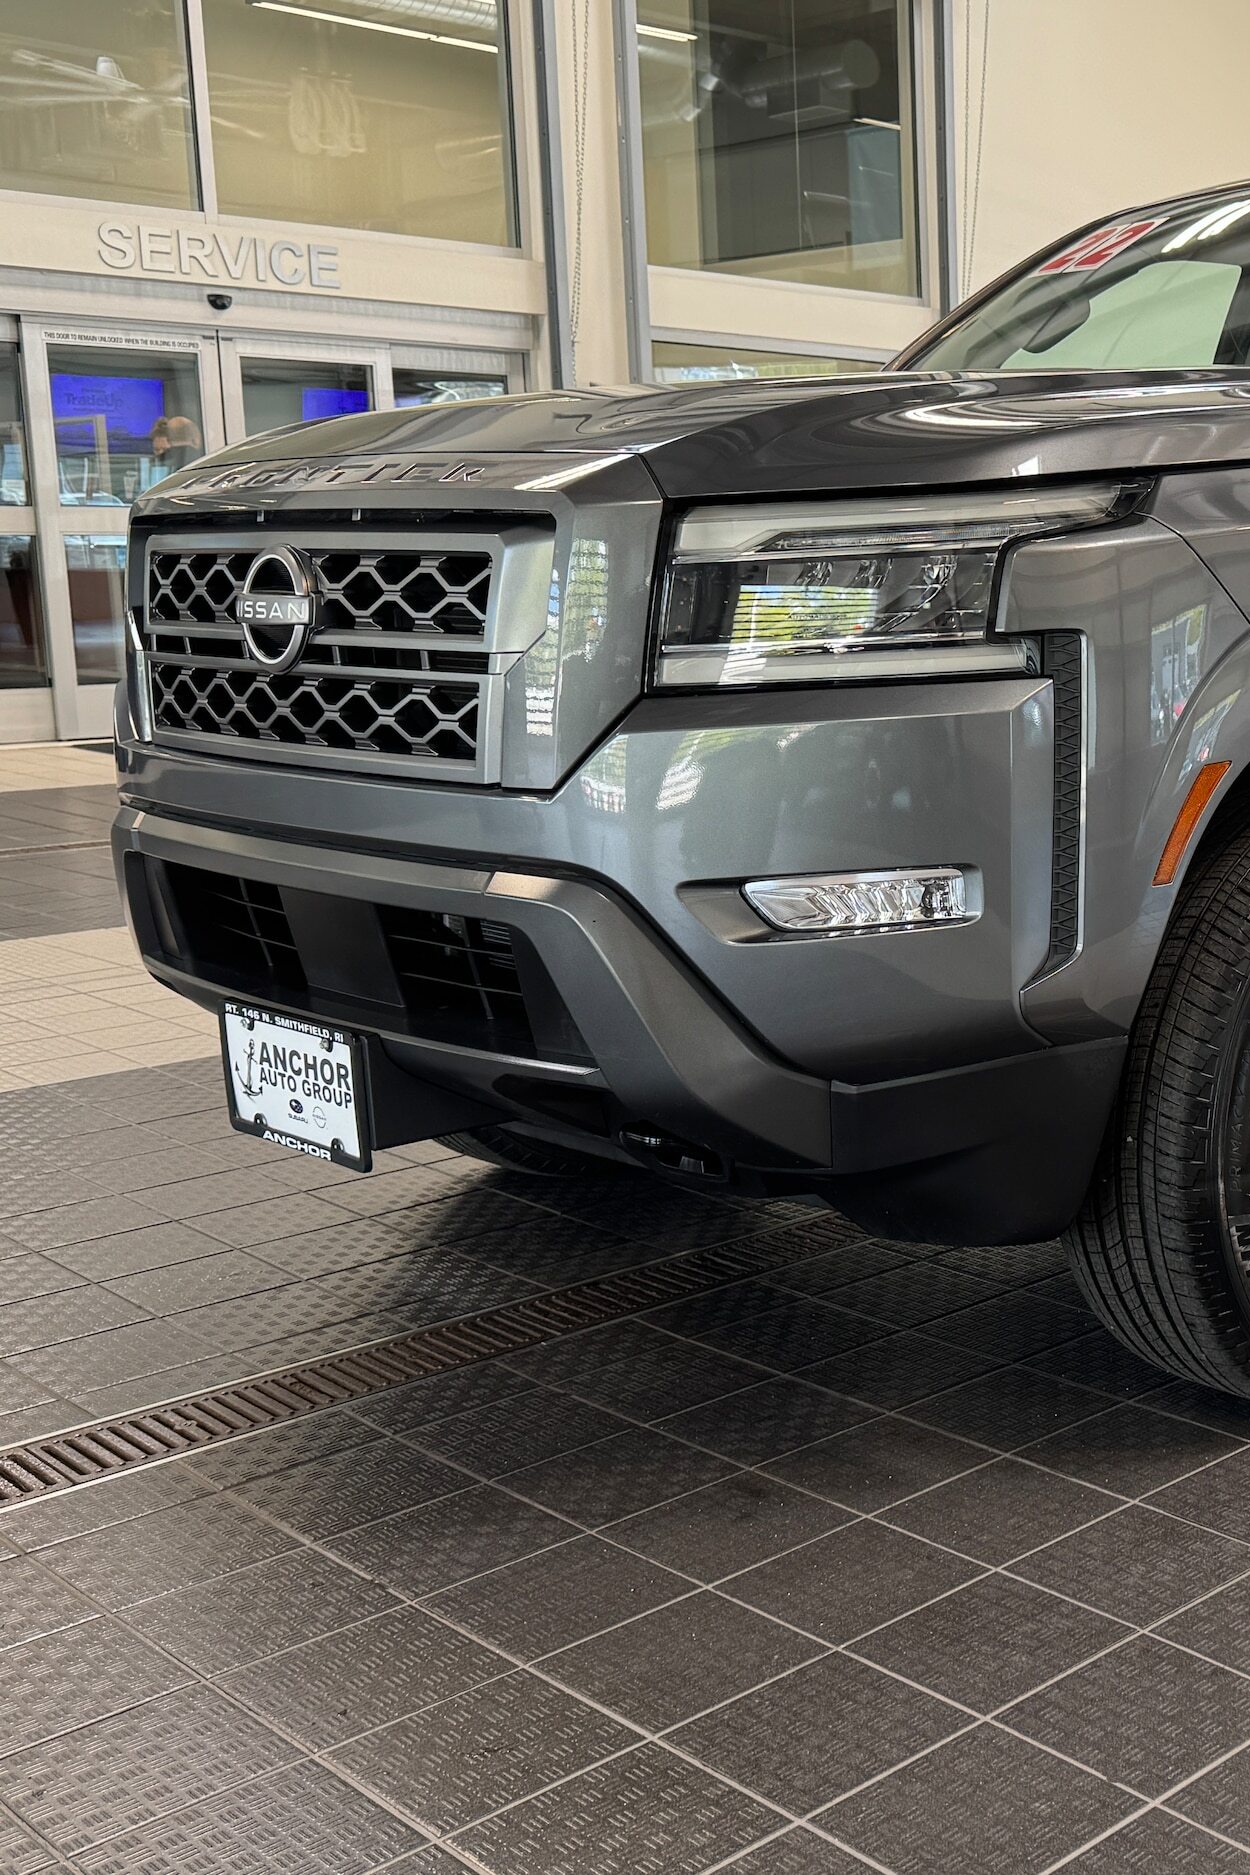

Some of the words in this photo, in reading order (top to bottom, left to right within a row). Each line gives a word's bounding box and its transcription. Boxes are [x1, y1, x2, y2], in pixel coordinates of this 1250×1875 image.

[98, 221, 341, 289] SERVICE
[1038, 221, 1155, 272] 22
[56, 332, 70, 340] DOOR
[78, 334, 97, 342] REMAIN
[98, 335, 123, 344] UNLOCKED
[124, 337, 140, 345] WHEN
[150, 338, 171, 347] BUILDING
[172, 340, 176, 348] IS
[176, 340, 200, 349] OCCUPIED
[224, 1002, 239, 1014] RT.
[242, 1008, 260, 1020] 146
[262, 1012, 273, 1024] N.
[274, 1016, 333, 1041] SMITHFIELD,
[334, 1032, 344, 1043] RI
[258, 1042, 350, 1091] ANCHOR
[260, 1066, 297, 1093] AUTO
[302, 1079, 352, 1110] GROUP
[262, 1130, 332, 1162] ANCHOR
